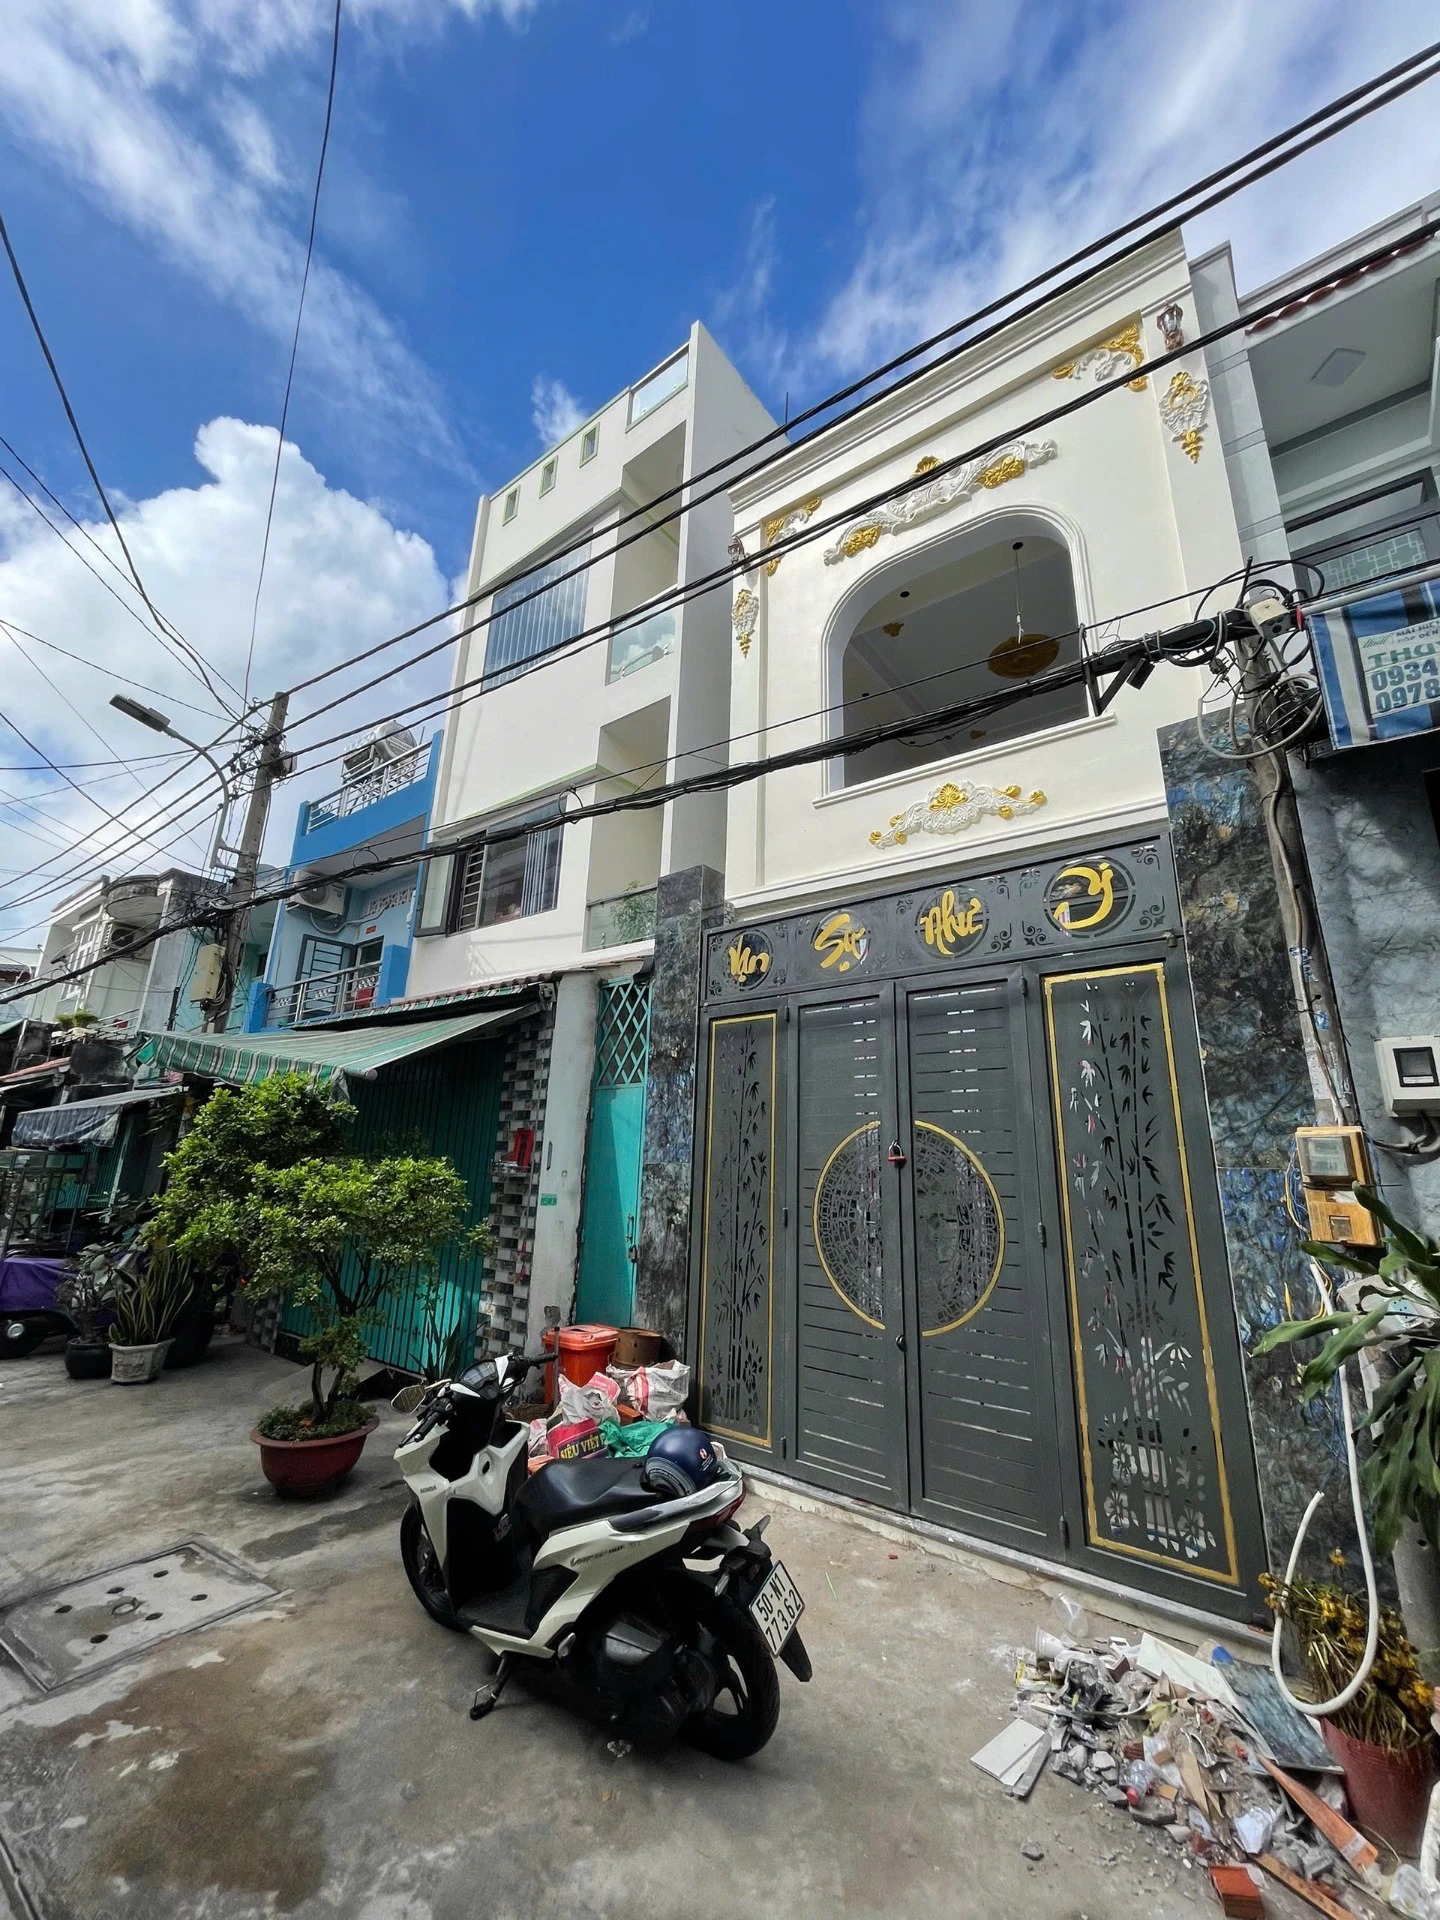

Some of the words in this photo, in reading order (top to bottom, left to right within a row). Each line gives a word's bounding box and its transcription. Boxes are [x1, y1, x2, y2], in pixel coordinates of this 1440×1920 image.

[1371, 657, 1439, 692] 0934
[1376, 678, 1440, 712] 0978
[755, 1572, 786, 1622] 50-N1
[765, 1589, 801, 1652] 773.62
